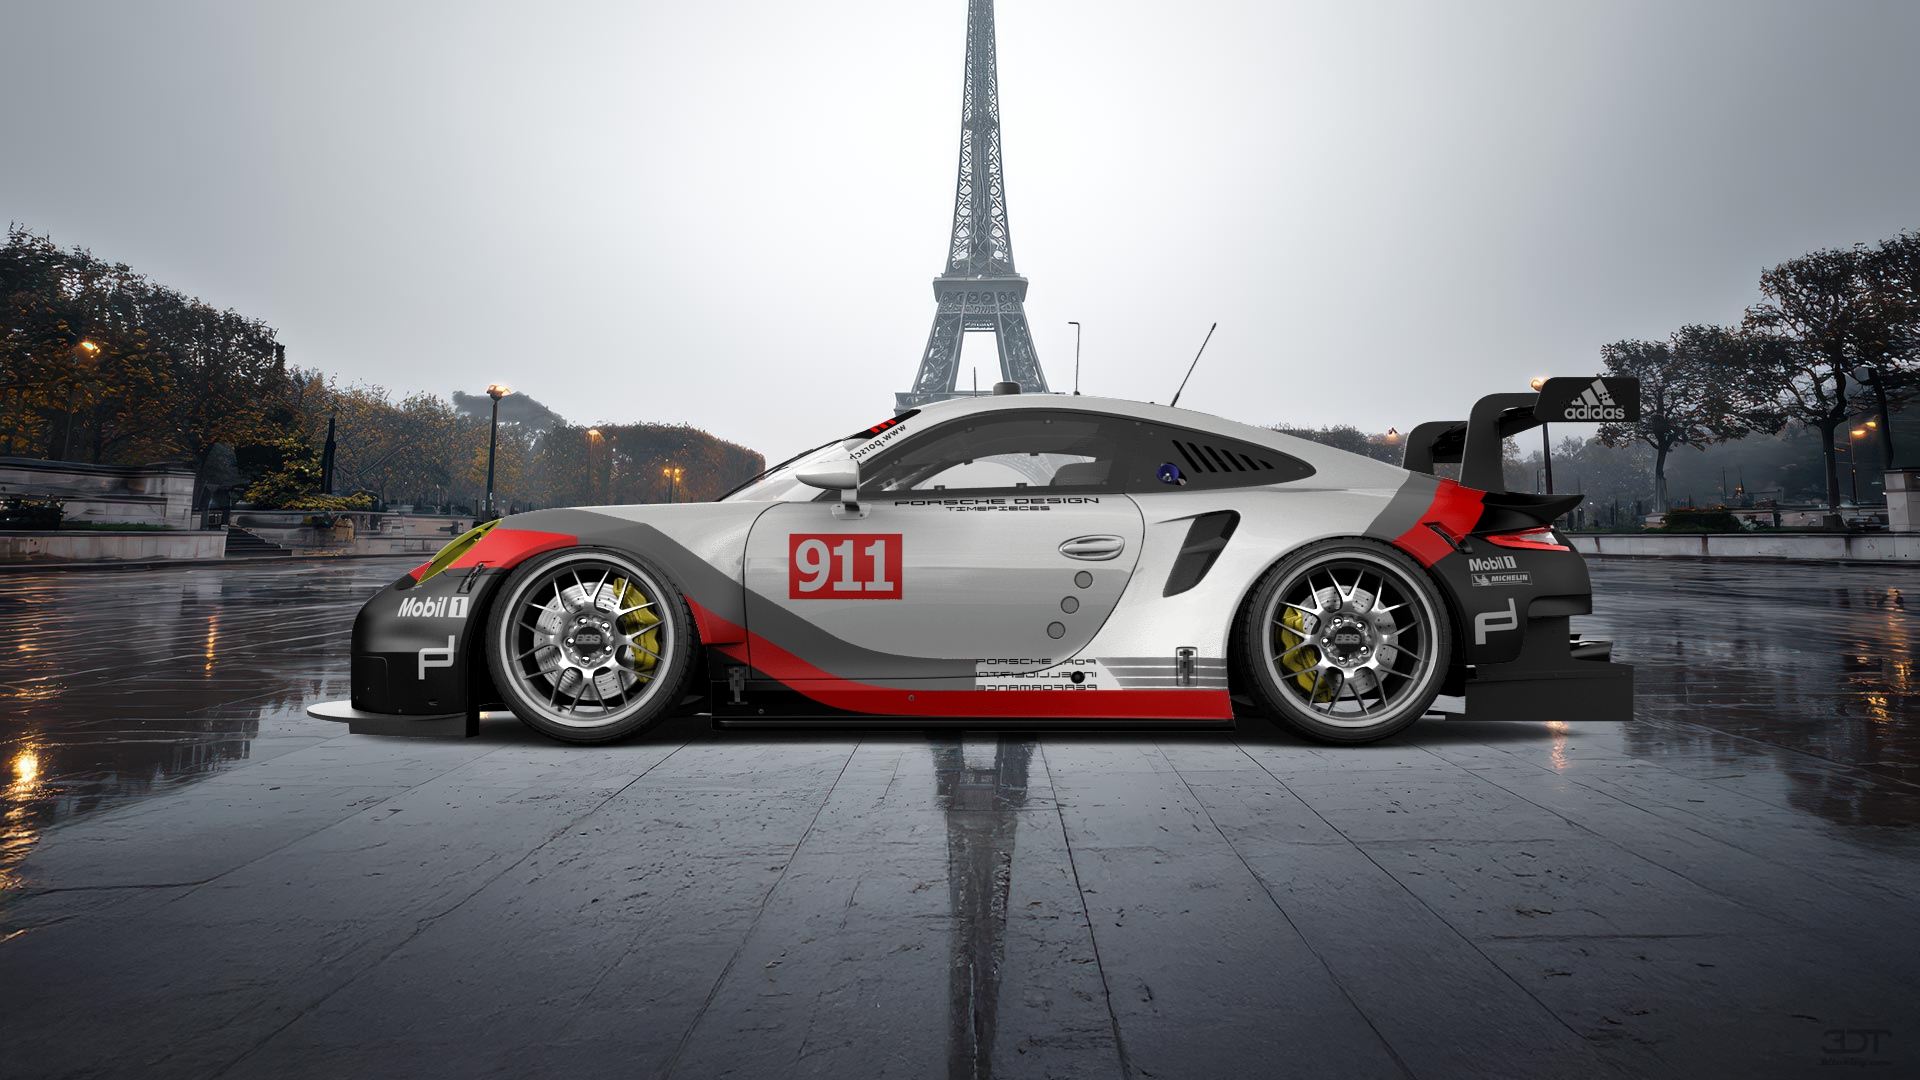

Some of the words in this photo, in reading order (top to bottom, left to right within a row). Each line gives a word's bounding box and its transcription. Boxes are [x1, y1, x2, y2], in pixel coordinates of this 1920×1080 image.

[1564, 404, 1625, 420] adidas
[895, 498, 1006, 506] PORSCHE
[1014, 497, 1100, 505] DESIGN
[795, 538, 894, 592] 911
[1468, 556, 1505, 571] Mobil
[1503, 555, 1517, 569] 1
[1491, 574, 1528, 582] MICHELIN
[397, 596, 448, 618] Mobil
[448, 596, 470, 618] 1
[575, 634, 601, 645] BBS
[1334, 633, 1360, 644] BBS
